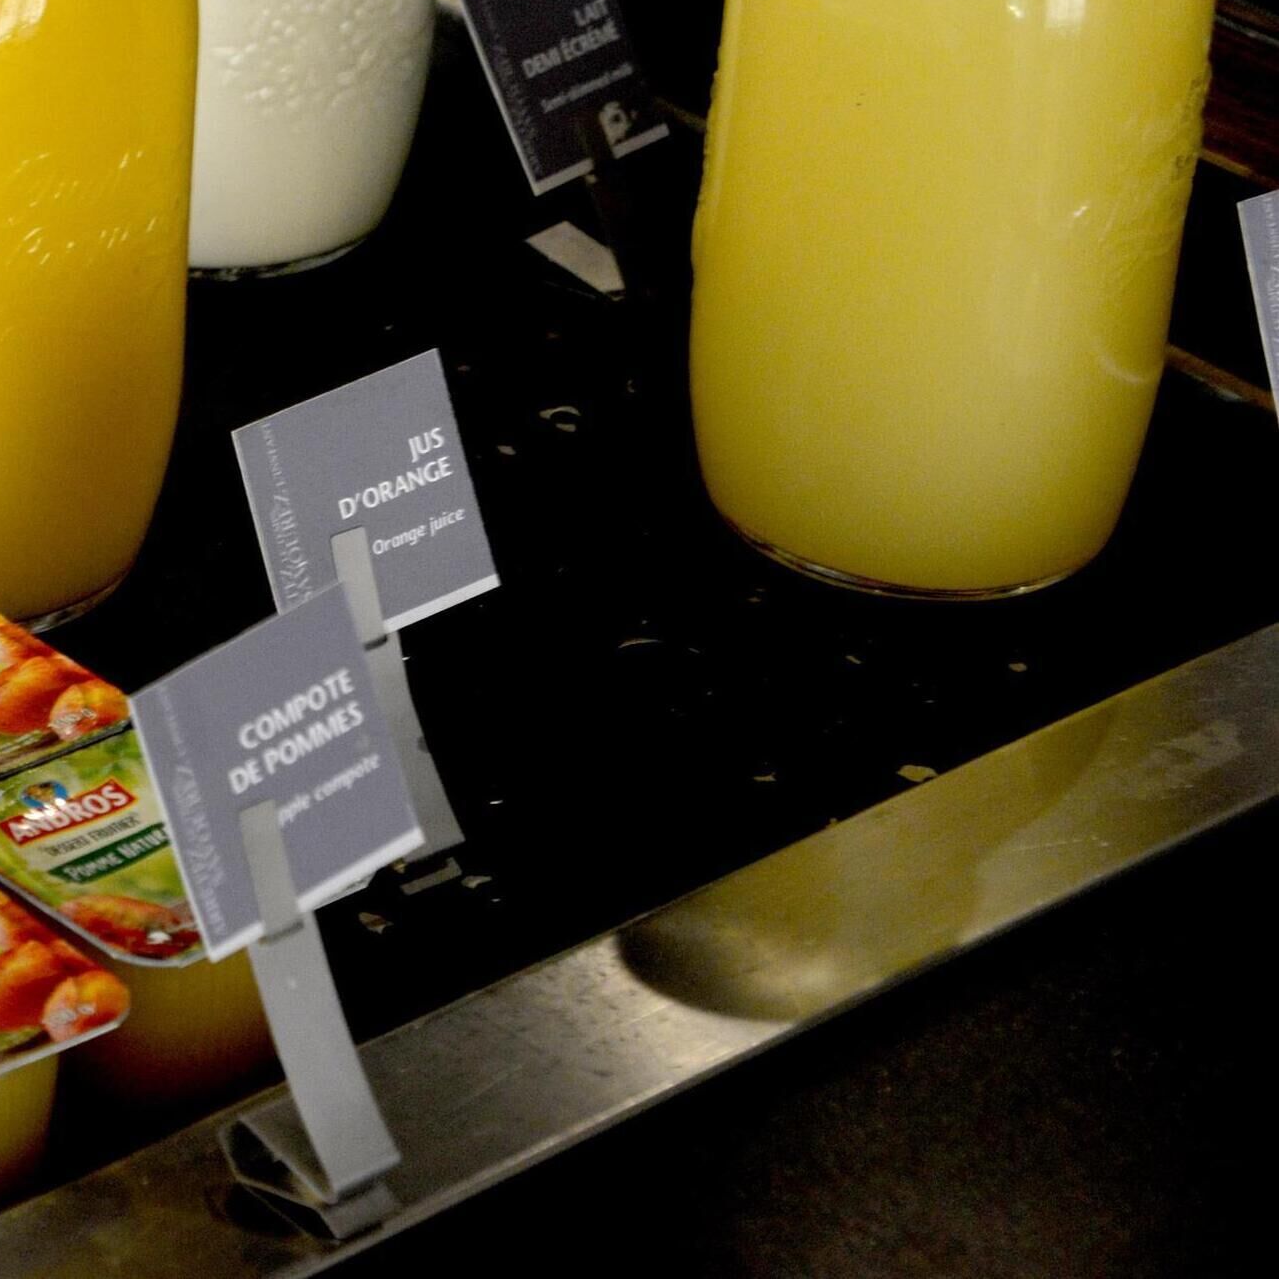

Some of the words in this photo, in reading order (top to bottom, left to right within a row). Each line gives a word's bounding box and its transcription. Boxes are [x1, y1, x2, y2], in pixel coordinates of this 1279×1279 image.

[408, 426, 445, 463] JUS
[338, 455, 453, 520] D'ORANGE
[372, 523, 428, 556] Orange
[428, 508, 466, 537] juice
[238, 666, 356, 750] COMPOTE
[228, 759, 265, 796] DE
[262, 699, 364, 775] POMMES
[7, 783, 130, 842] ANDROS
